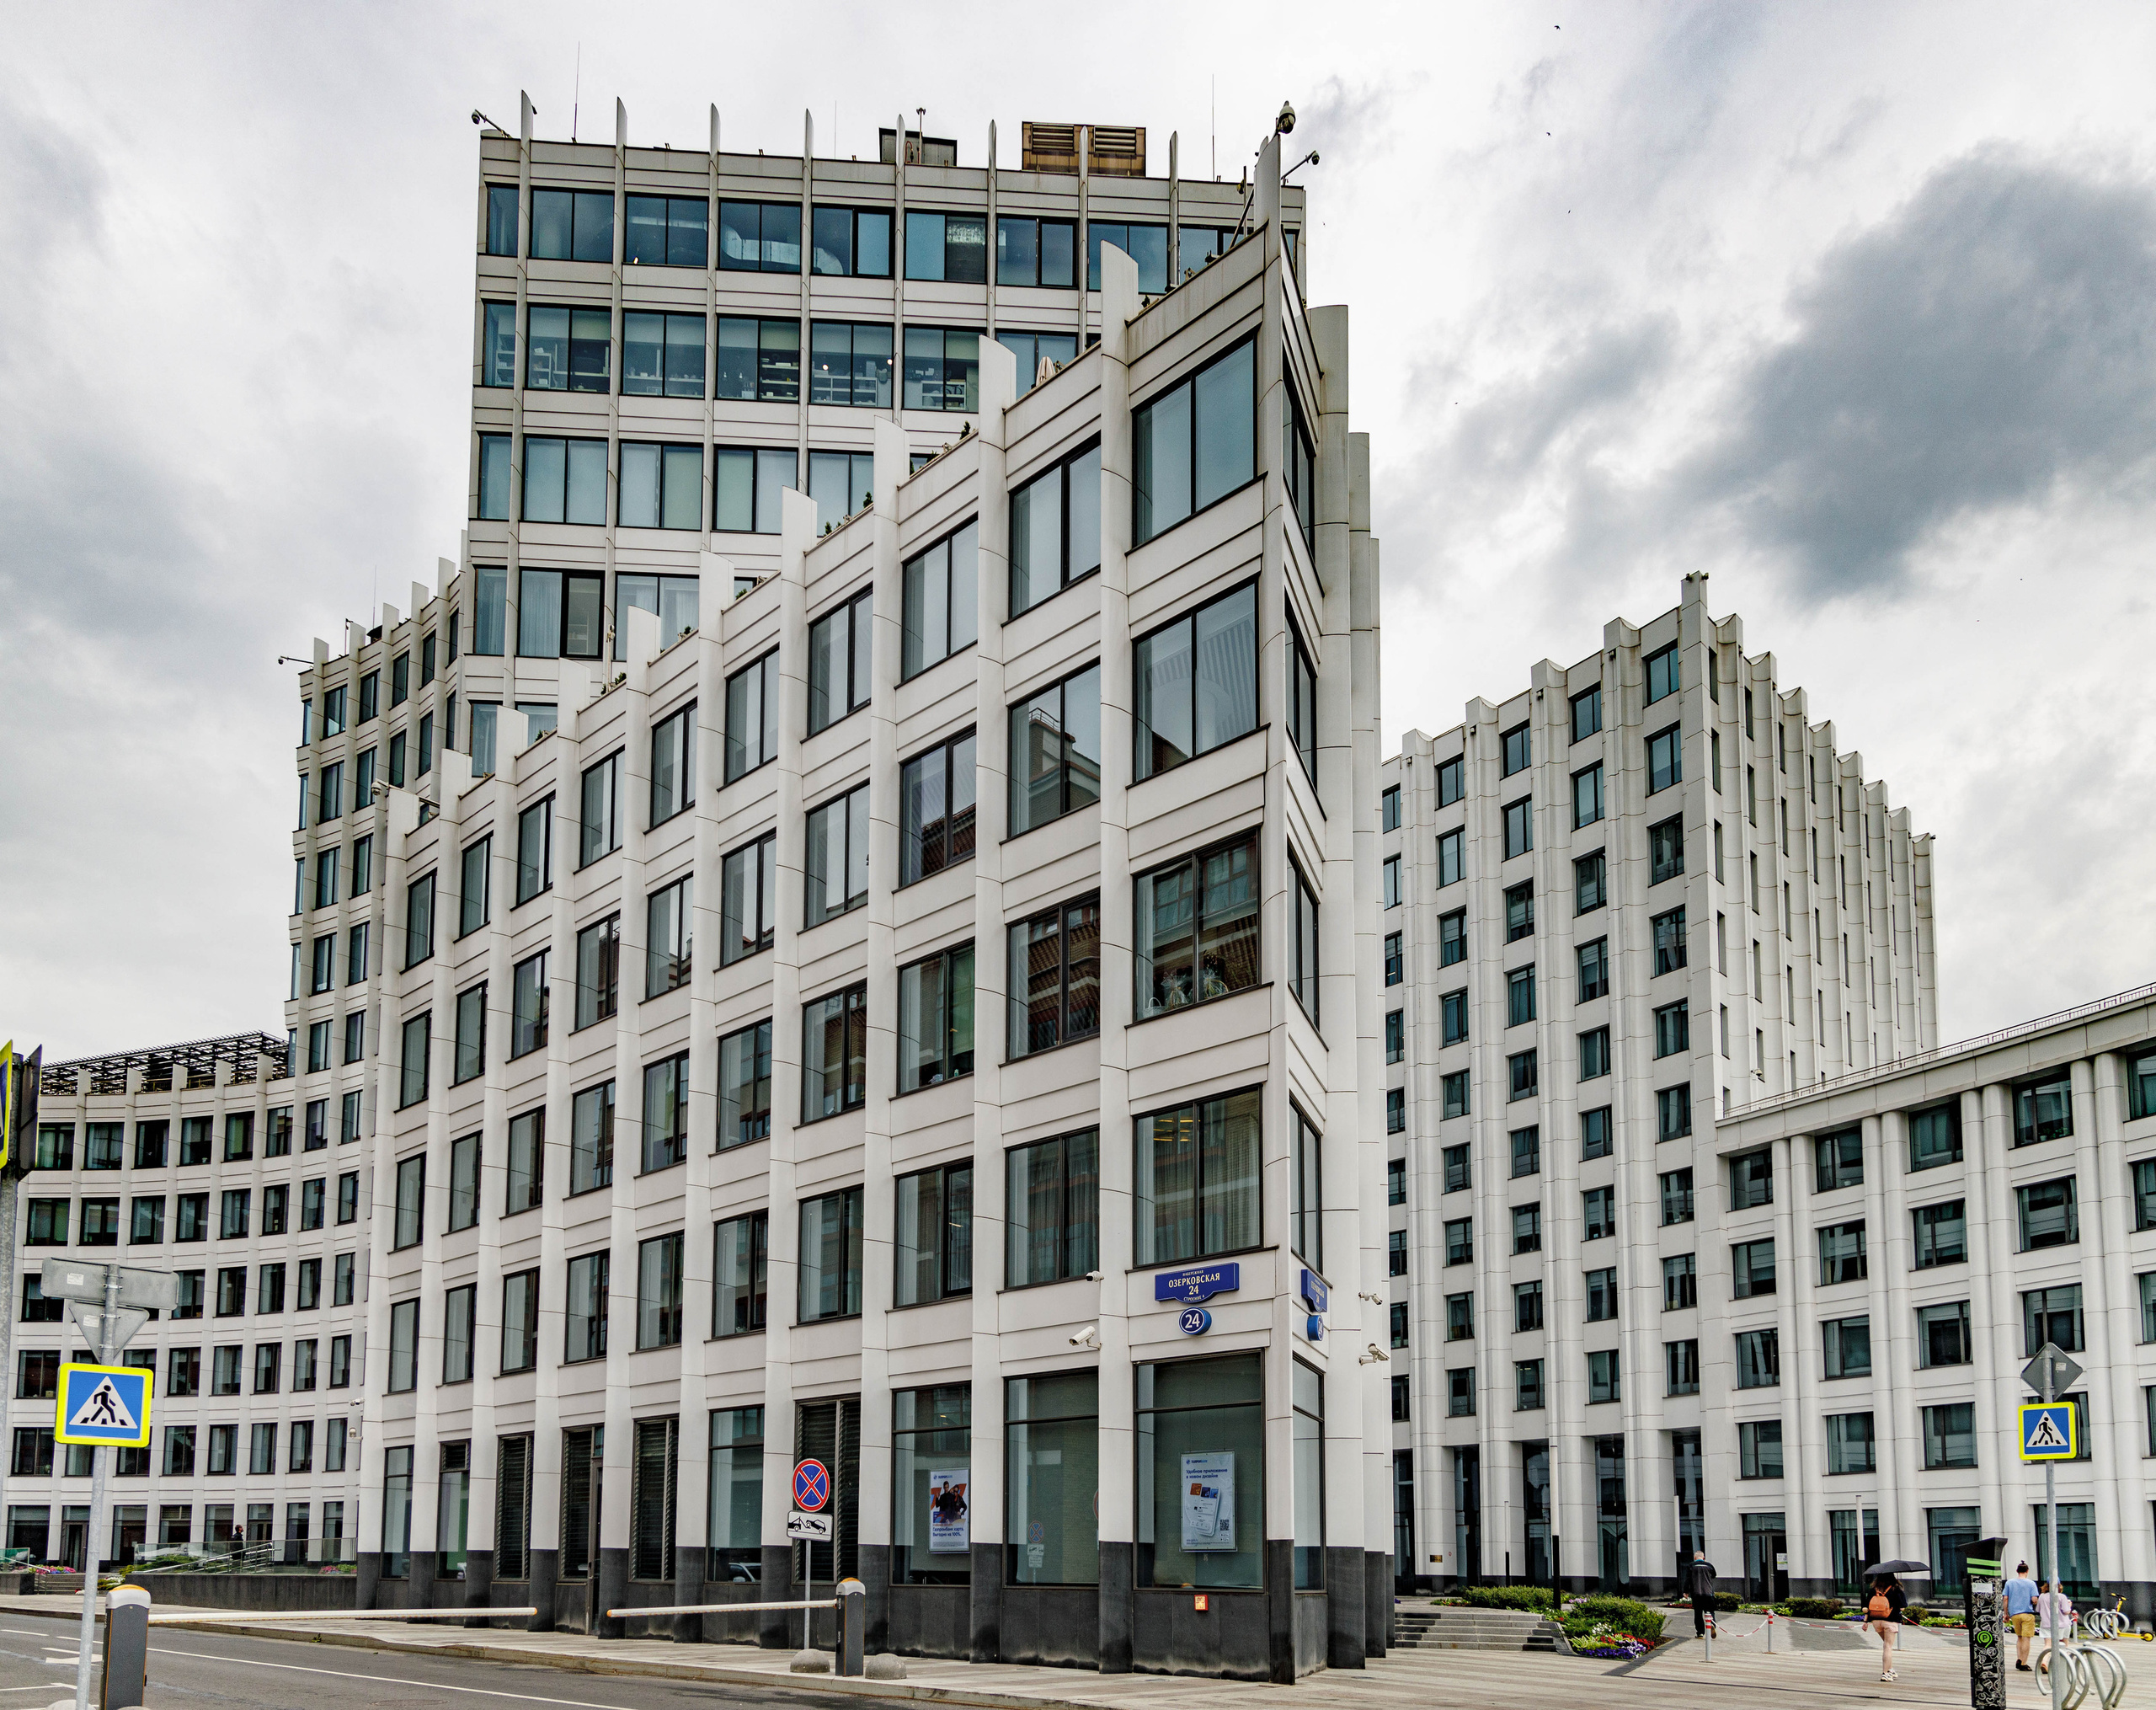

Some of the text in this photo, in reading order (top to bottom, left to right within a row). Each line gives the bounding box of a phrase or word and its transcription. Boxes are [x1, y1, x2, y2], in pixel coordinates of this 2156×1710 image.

[1168, 1272, 1220, 1288] ОЗЕРКОВСКАЯ
[1188, 1285, 1199, 1295] 24
[1184, 1312, 1200, 1328] 24
